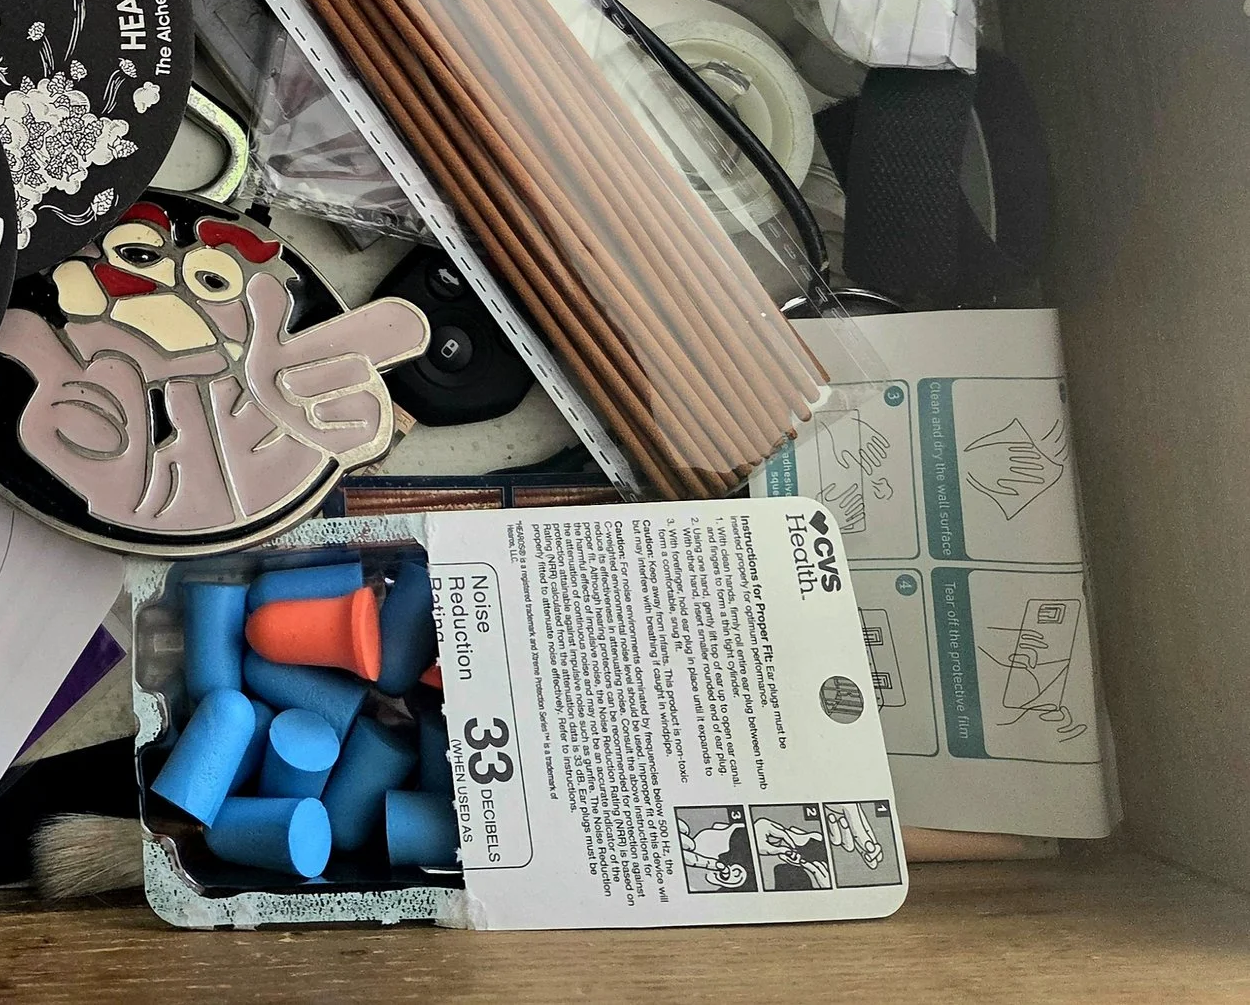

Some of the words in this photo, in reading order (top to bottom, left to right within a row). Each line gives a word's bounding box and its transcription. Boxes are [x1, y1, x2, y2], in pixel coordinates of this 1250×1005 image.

[156, 46, 172, 76] The
[886, 391, 900, 401] 3
[928, 381, 941, 415] Clean
[931, 417, 943, 438] and
[931, 441, 946, 460] dry
[933, 463, 945, 481] the
[936, 484, 949, 509] wall
[705, 526, 715, 543] and
[716, 526, 727, 547] With
[730, 515, 741, 550] inserted
[939, 512, 953, 556] surface
[707, 545, 722, 574] fingers
[719, 548, 729, 572] clean
[739, 515, 758, 581] Instructions
[785, 513, 815, 595] Health
[732, 552, 749, 589] properly
[812, 536, 841, 592] CVS
[714, 577, 723, 586] to
[722, 574, 735, 604] hands,
[752, 584, 761, 599] for
[899, 580, 912, 590] 4
[470, 575, 490, 633] Noise
[716, 588, 728, 609] form
[741, 591, 750, 603] for
[943, 582, 957, 607] Tear
[447, 577, 472, 680] Reduction
[721, 619, 731, 636] thin
[727, 606, 742, 631] firmly
[743, 605, 758, 645] optimum
[754, 603, 770, 641] Proper
[946, 610, 960, 626] off
[722, 638, 735, 658] tight
[732, 633, 743, 647] roll
[948, 628, 960, 648] the
[735, 649, 747, 674] entire
[761, 645, 773, 662] Fit:
[725, 660, 740, 698] cylinder.
[740, 677, 749, 692] ear
[750, 647, 769, 708] performance.
[765, 666, 775, 680] Ear
[948, 651, 966, 712] protective
[740, 694, 755, 714] plug
[766, 683, 780, 708] plugs
[771, 711, 784, 734] must
[957, 715, 970, 739] film
[746, 717, 760, 757] between
[777, 737, 787, 749] be
[450, 738, 465, 782] (WHEN
[463, 717, 514, 785] 33
[754, 759, 767, 790] thumb
[456, 786, 470, 822] USED
[731, 811, 741, 820] 3
[806, 807, 817, 817] 2
[460, 825, 472, 843] AS
[480, 789, 500, 862] DECIBELS
